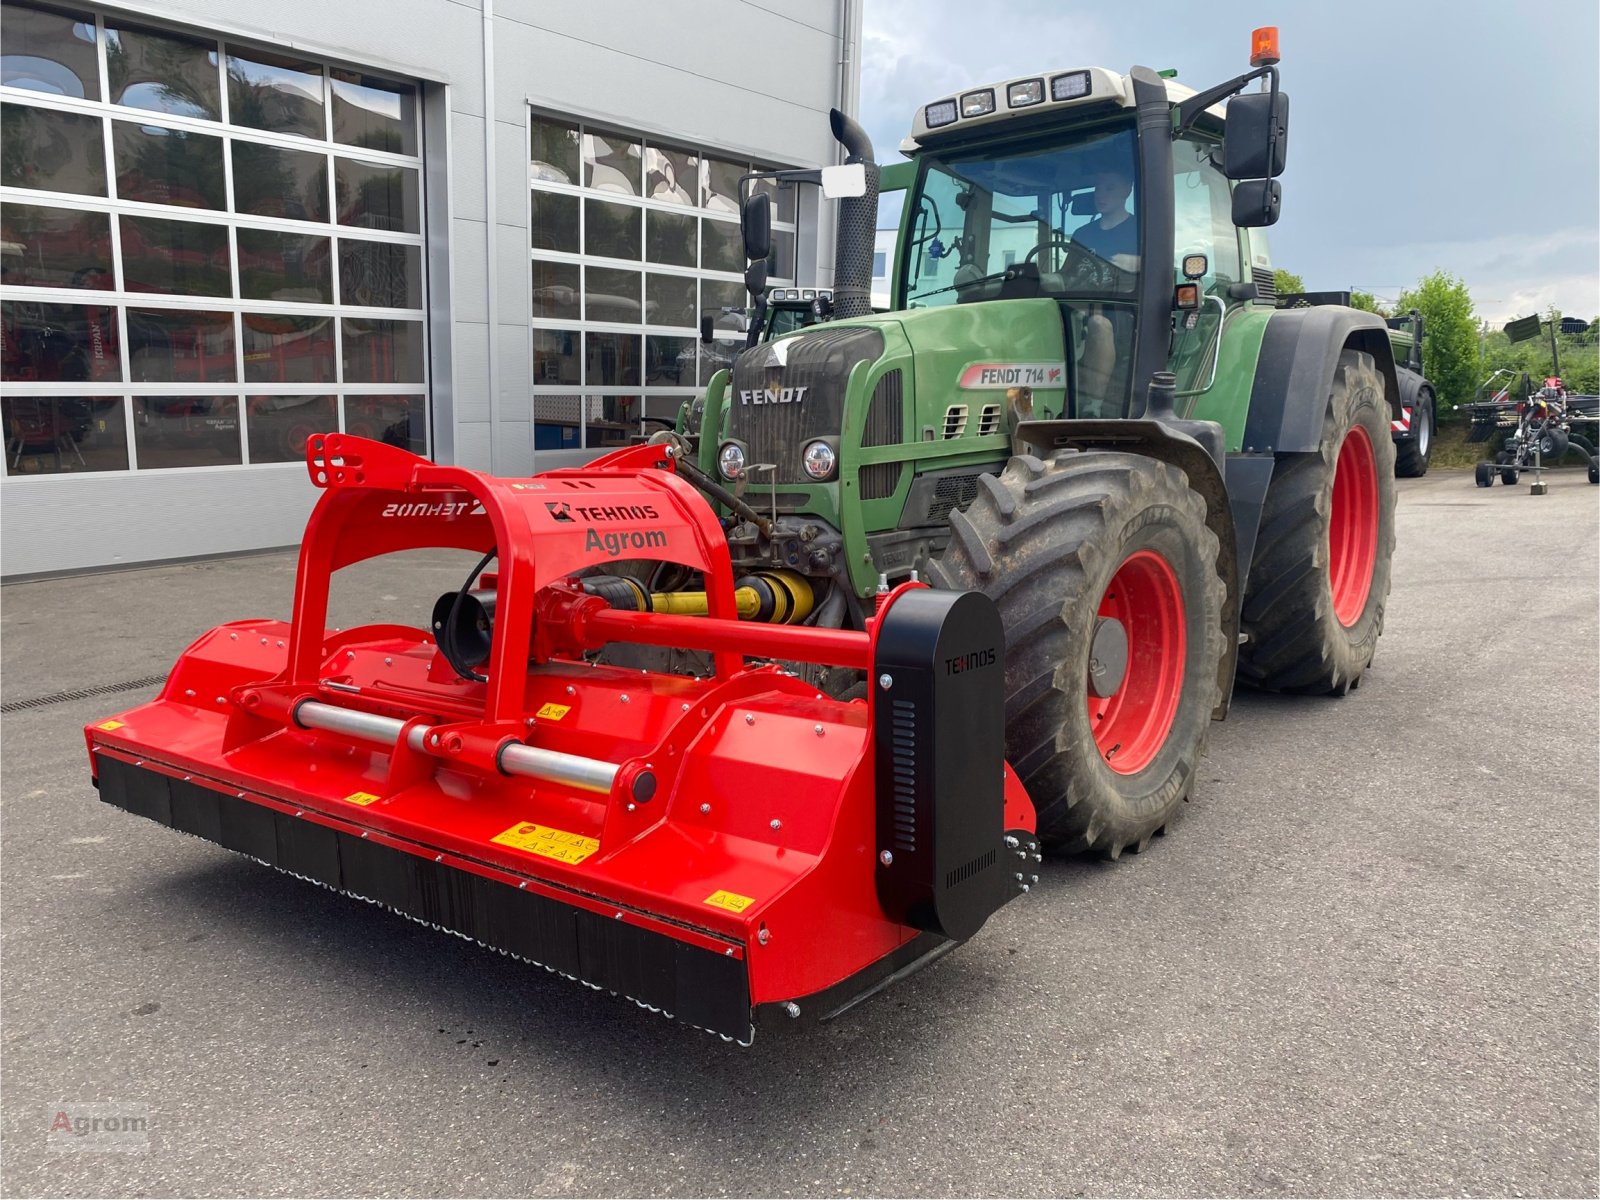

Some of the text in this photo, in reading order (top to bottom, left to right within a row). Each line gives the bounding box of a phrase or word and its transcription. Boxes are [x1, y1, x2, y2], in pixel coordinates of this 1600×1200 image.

[91, 324, 104, 359] KRPAN
[981, 368, 1021, 384] FENDT
[1026, 368, 1044, 383] 714
[740, 386, 808, 405] FENDT
[576, 505, 659, 521] TEHNOS
[585, 528, 667, 556] Agrom
[945, 648, 996, 676] TEHNOS
